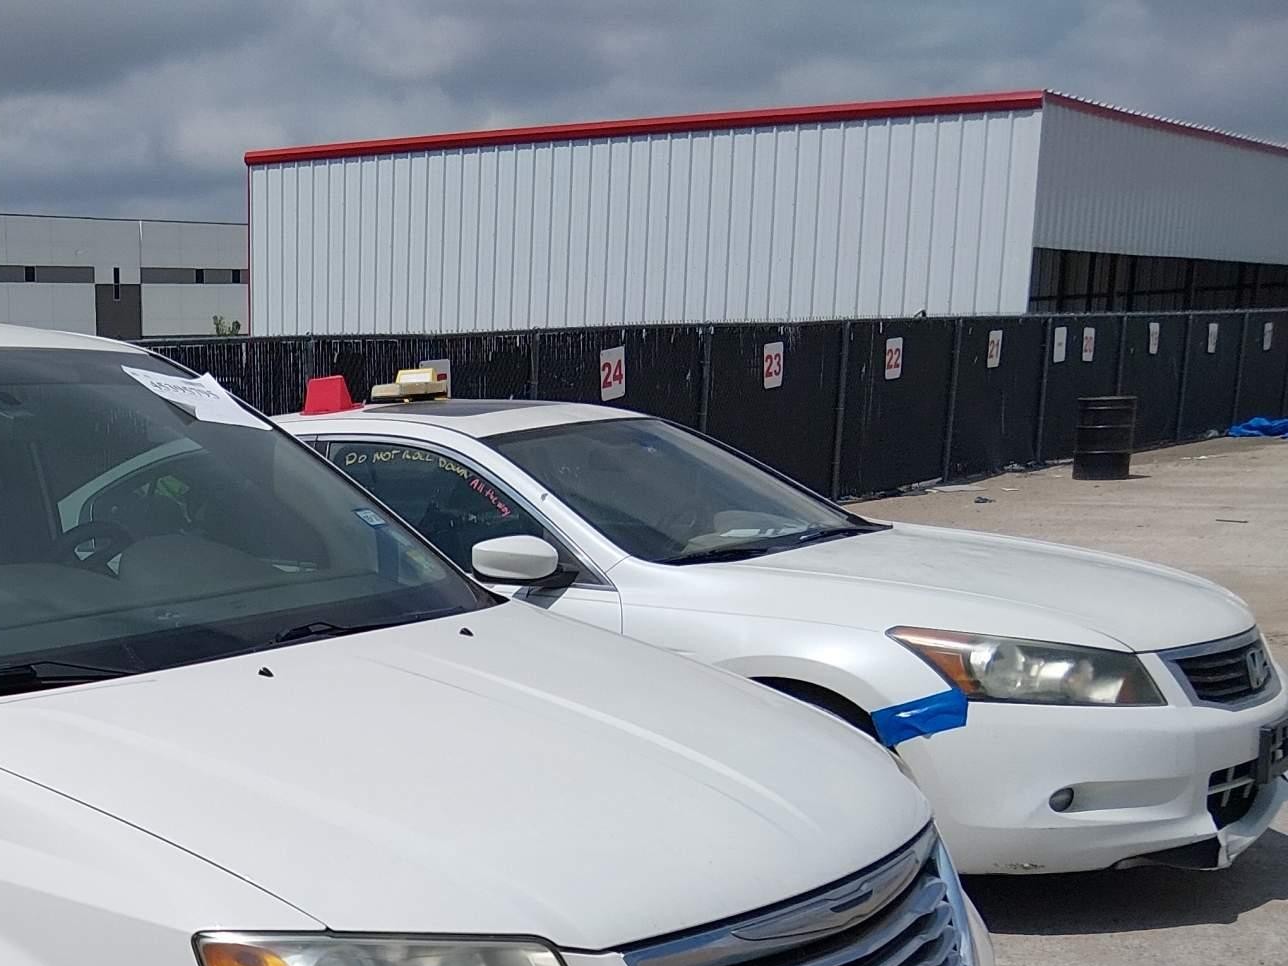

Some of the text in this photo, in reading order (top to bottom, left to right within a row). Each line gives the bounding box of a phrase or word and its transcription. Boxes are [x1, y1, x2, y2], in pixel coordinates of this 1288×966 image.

[886, 348, 900, 370] 22
[988, 335, 1001, 359] 21
[601, 359, 624, 388] 24
[764, 353, 783, 379] 23
[373, 450, 401, 463] NOT
